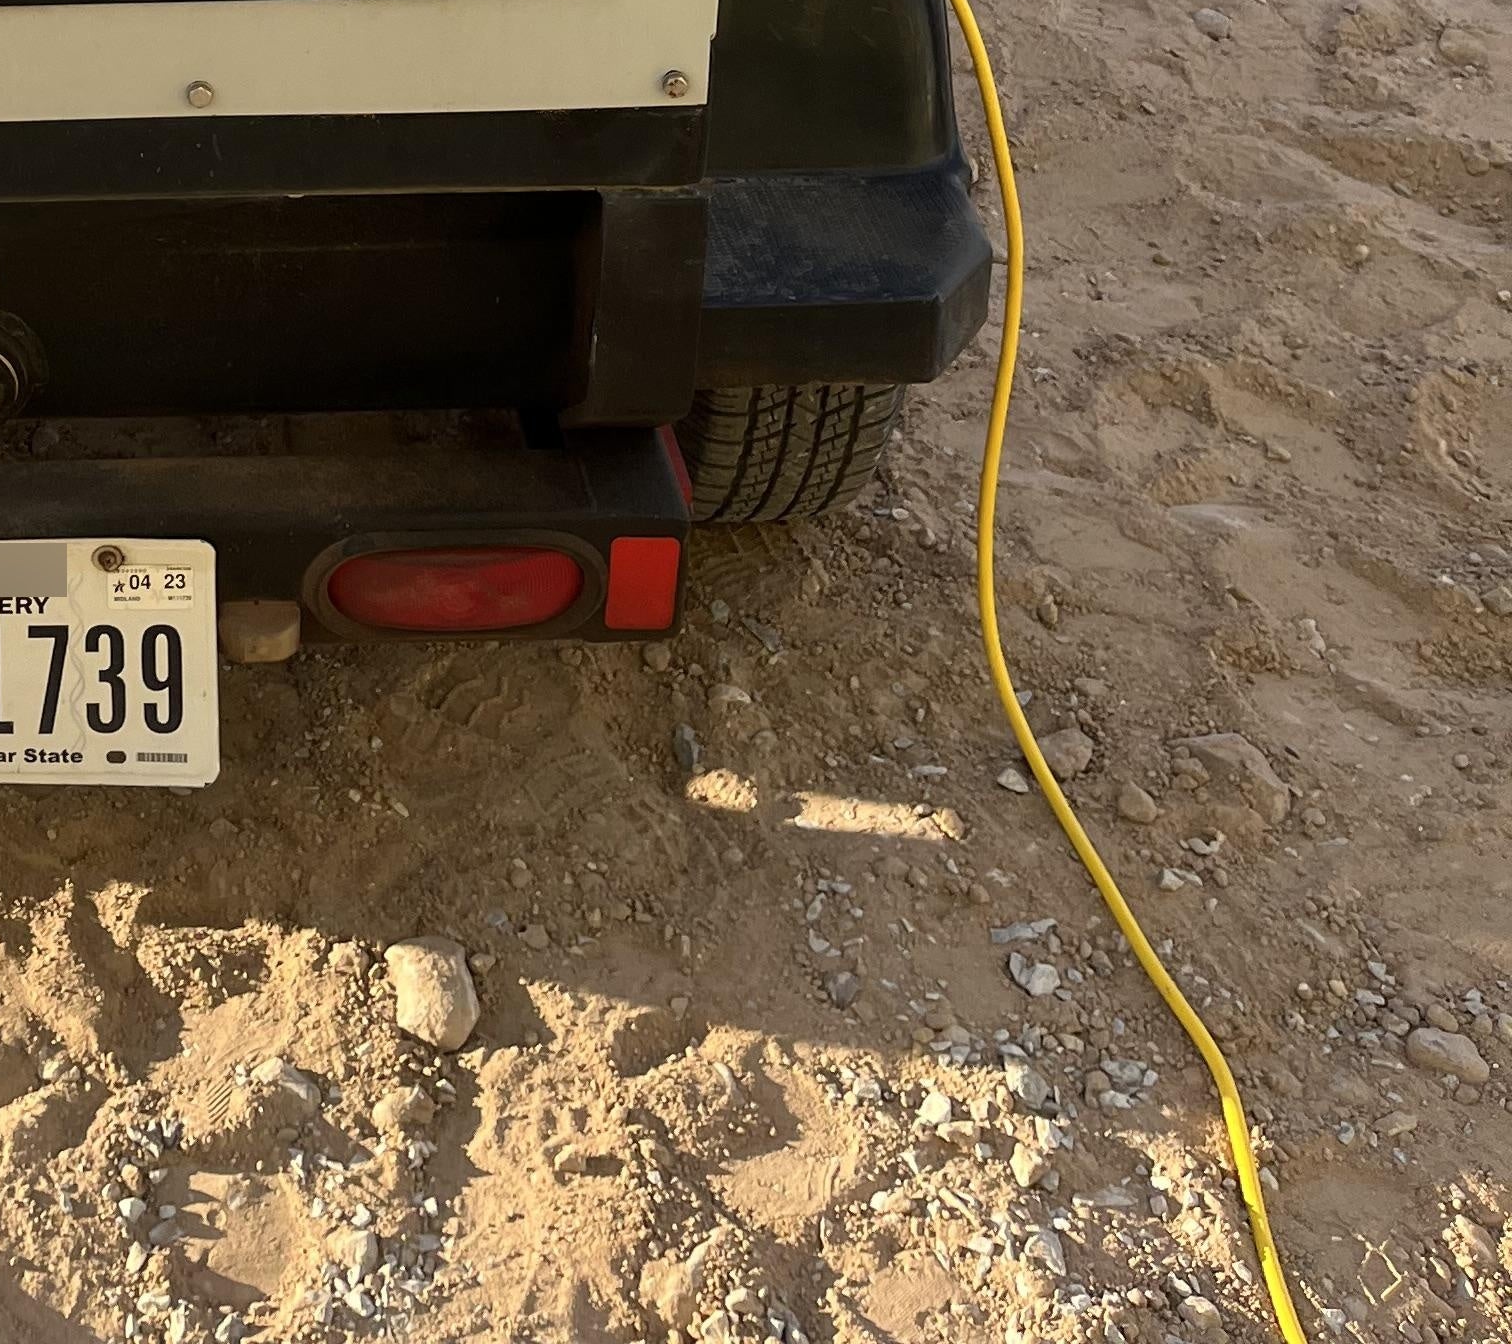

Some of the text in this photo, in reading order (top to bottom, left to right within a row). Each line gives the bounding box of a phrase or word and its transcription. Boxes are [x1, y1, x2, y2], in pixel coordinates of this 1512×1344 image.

[129, 573, 186, 590] 04 23
[23, 748, 84, 764] State
